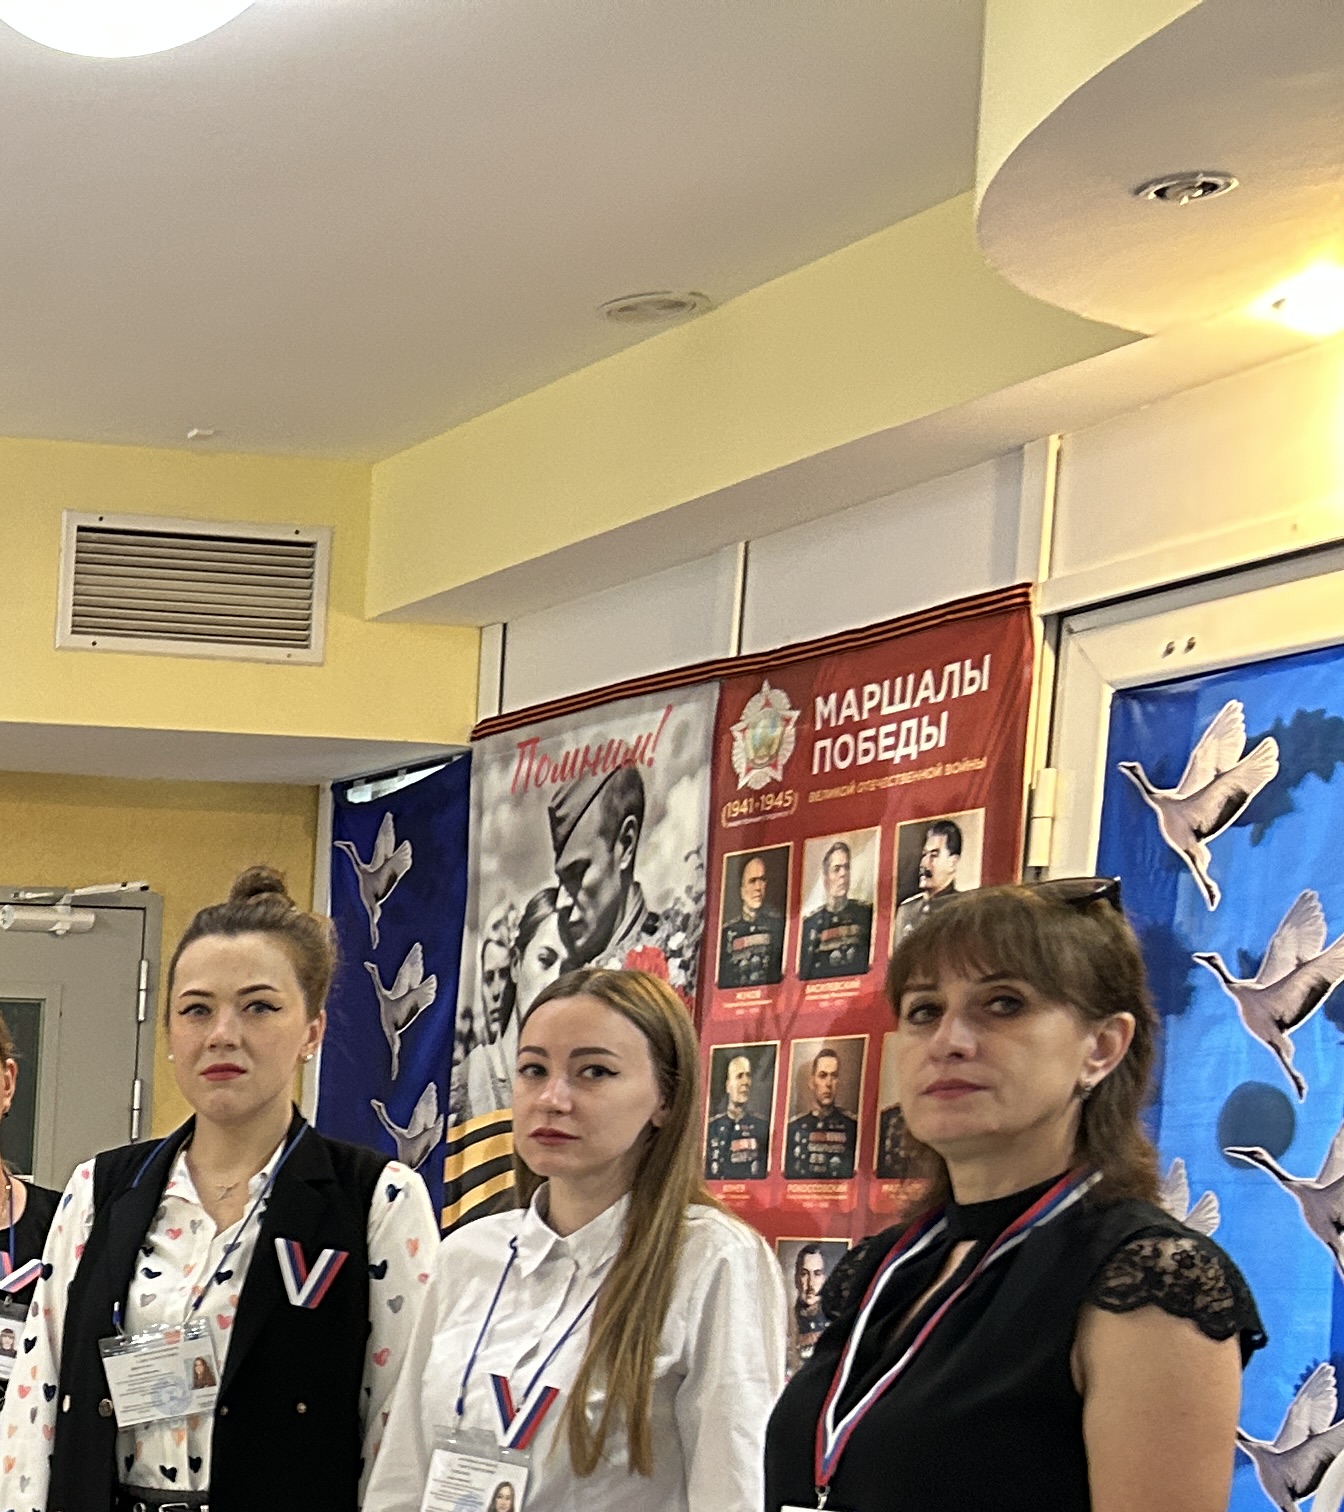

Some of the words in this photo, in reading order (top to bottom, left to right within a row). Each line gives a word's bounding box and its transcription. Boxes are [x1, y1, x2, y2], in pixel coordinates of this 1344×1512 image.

[814, 654, 992, 731] МАРШАЛЫ
[511, 704, 673, 796] Помним!
[811, 711, 950, 775] ПОБЕДЫ
[726, 789, 794, 818] 1941-1945
